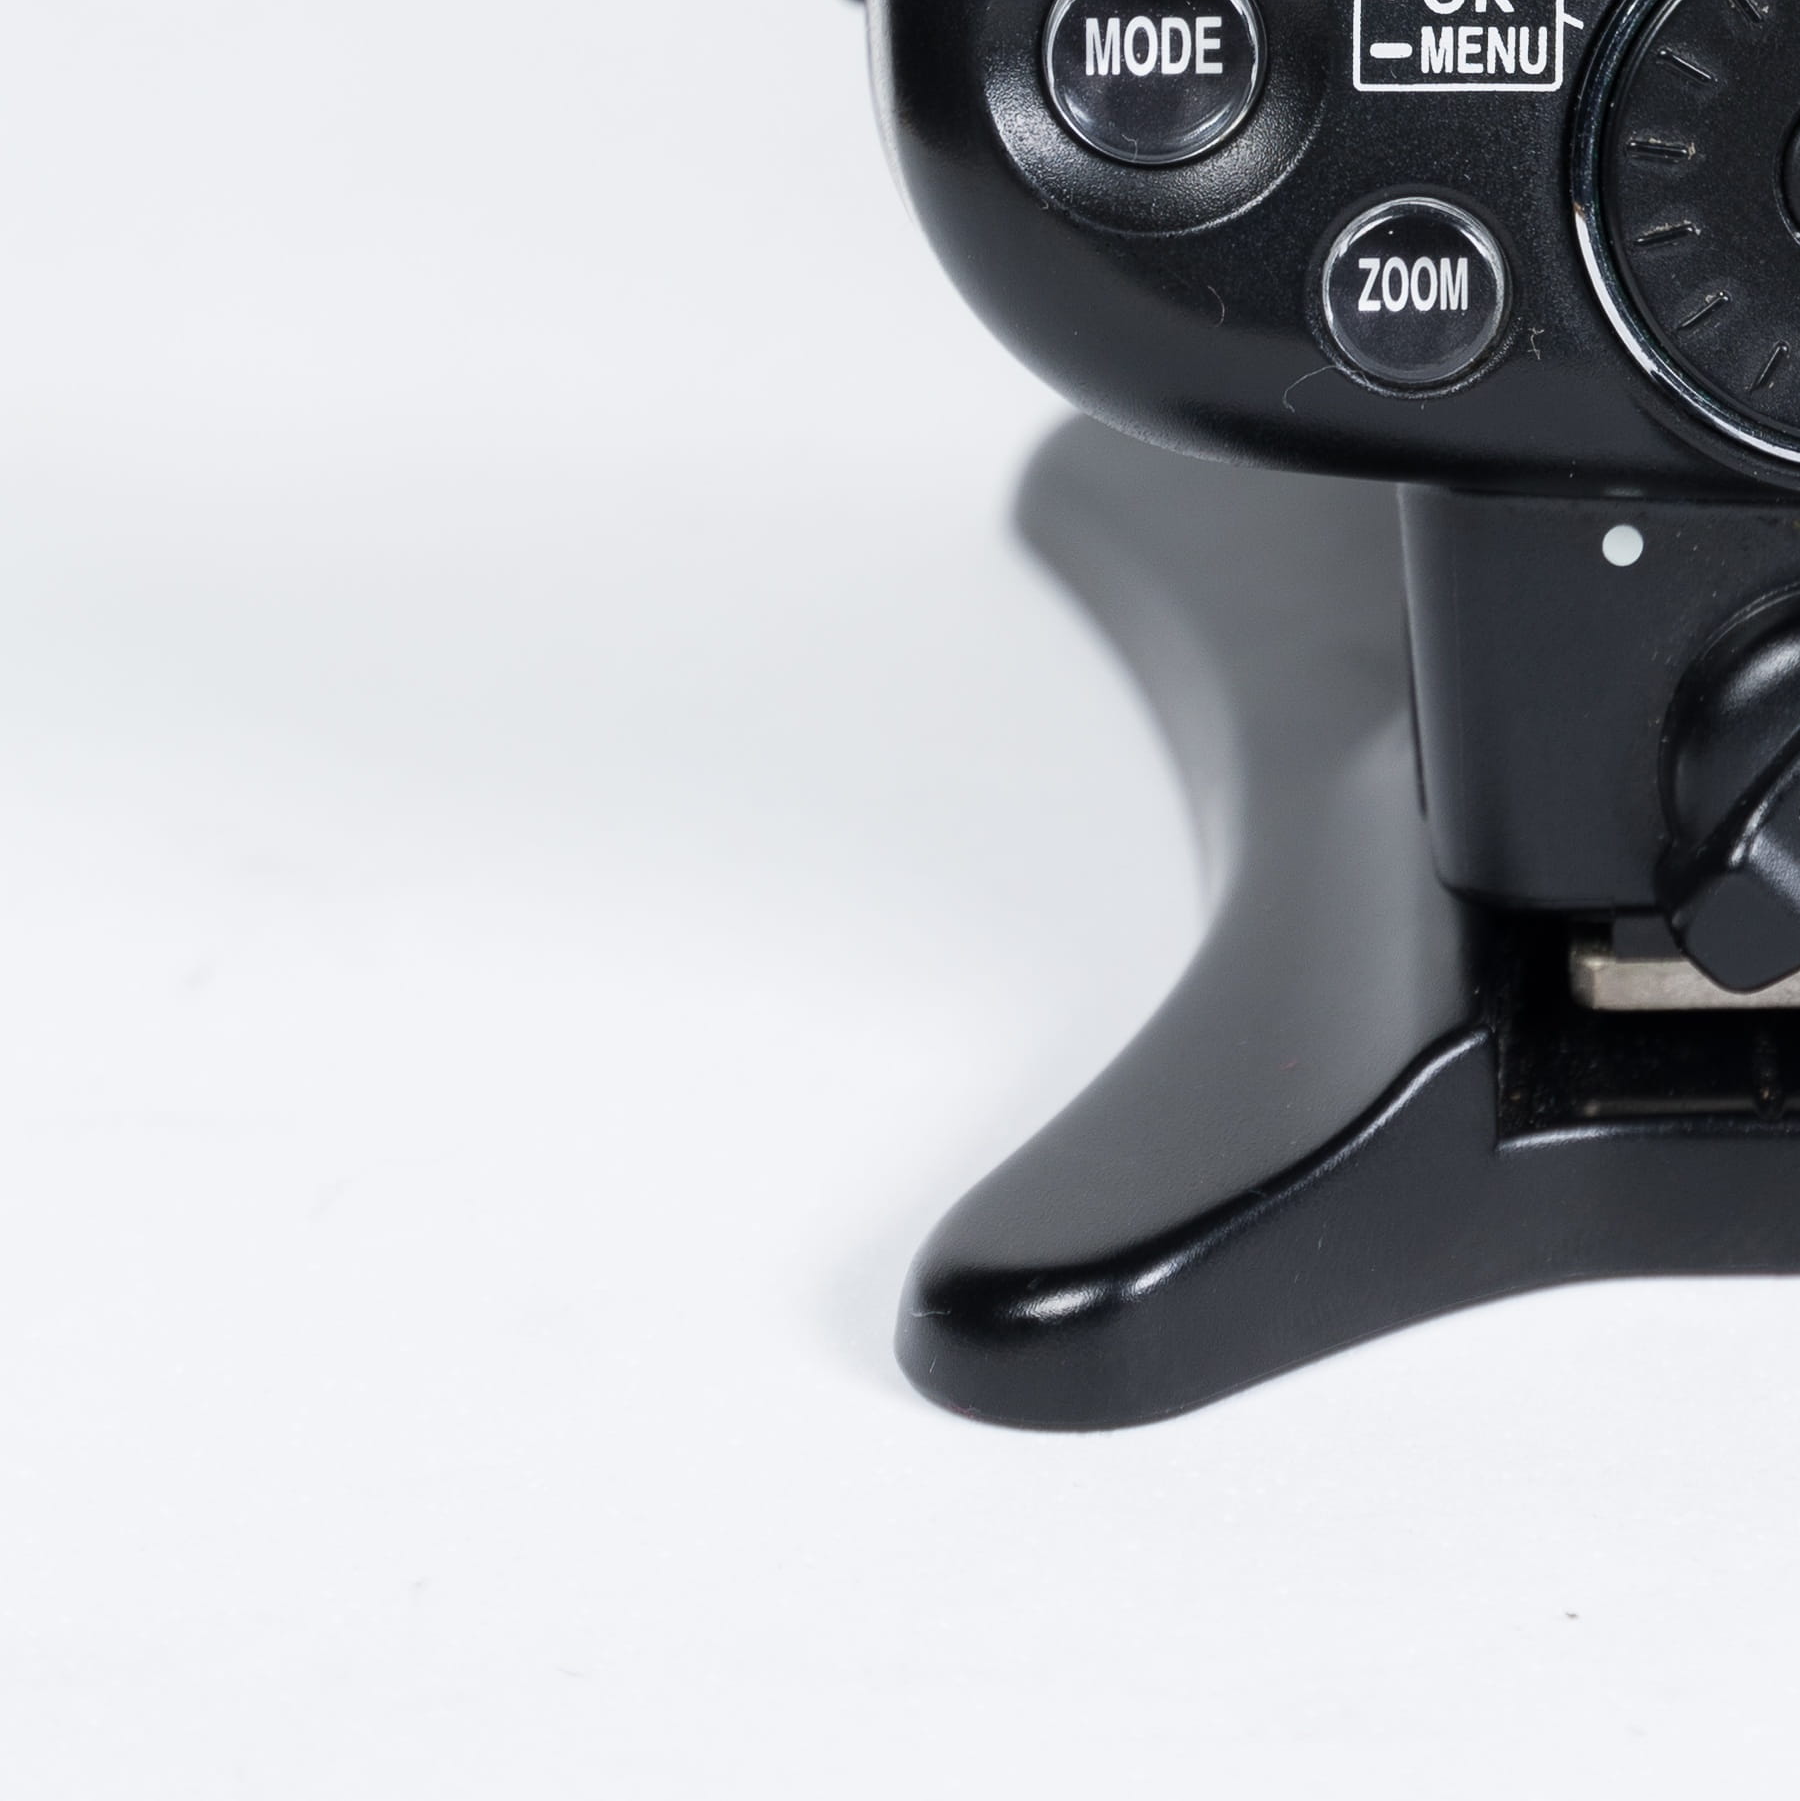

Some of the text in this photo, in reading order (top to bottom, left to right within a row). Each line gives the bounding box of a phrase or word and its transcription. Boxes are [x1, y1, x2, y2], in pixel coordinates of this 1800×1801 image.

[1083, 16, 1225, 77] MODE
[1418, 25, 1548, 75] MENU
[1356, 255, 1470, 313] ZOOM
